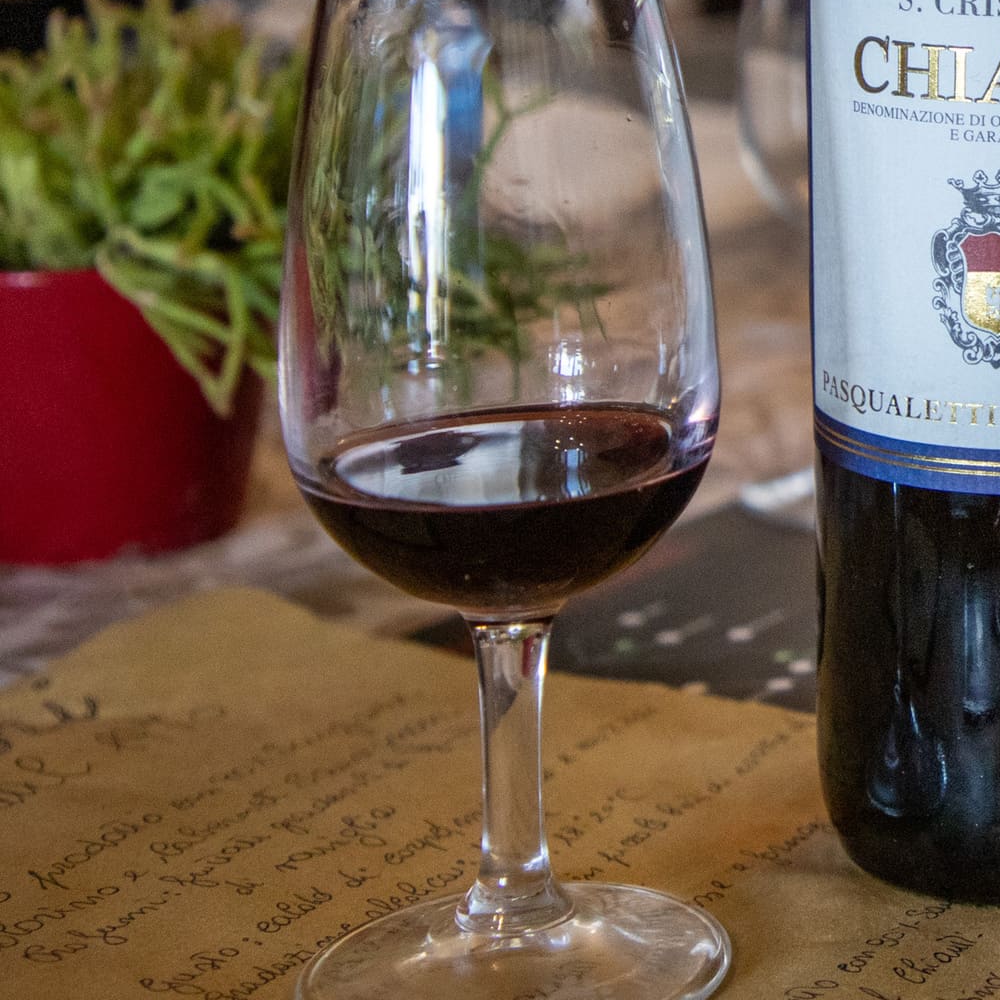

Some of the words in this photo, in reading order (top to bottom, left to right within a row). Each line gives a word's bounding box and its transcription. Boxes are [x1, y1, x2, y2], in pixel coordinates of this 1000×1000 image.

[852, 99, 965, 127] DENOMINAZIONE
[969, 114, 986, 127] DI
[949, 129, 960, 142] E
[822, 369, 997, 428] PASQUALETTI
